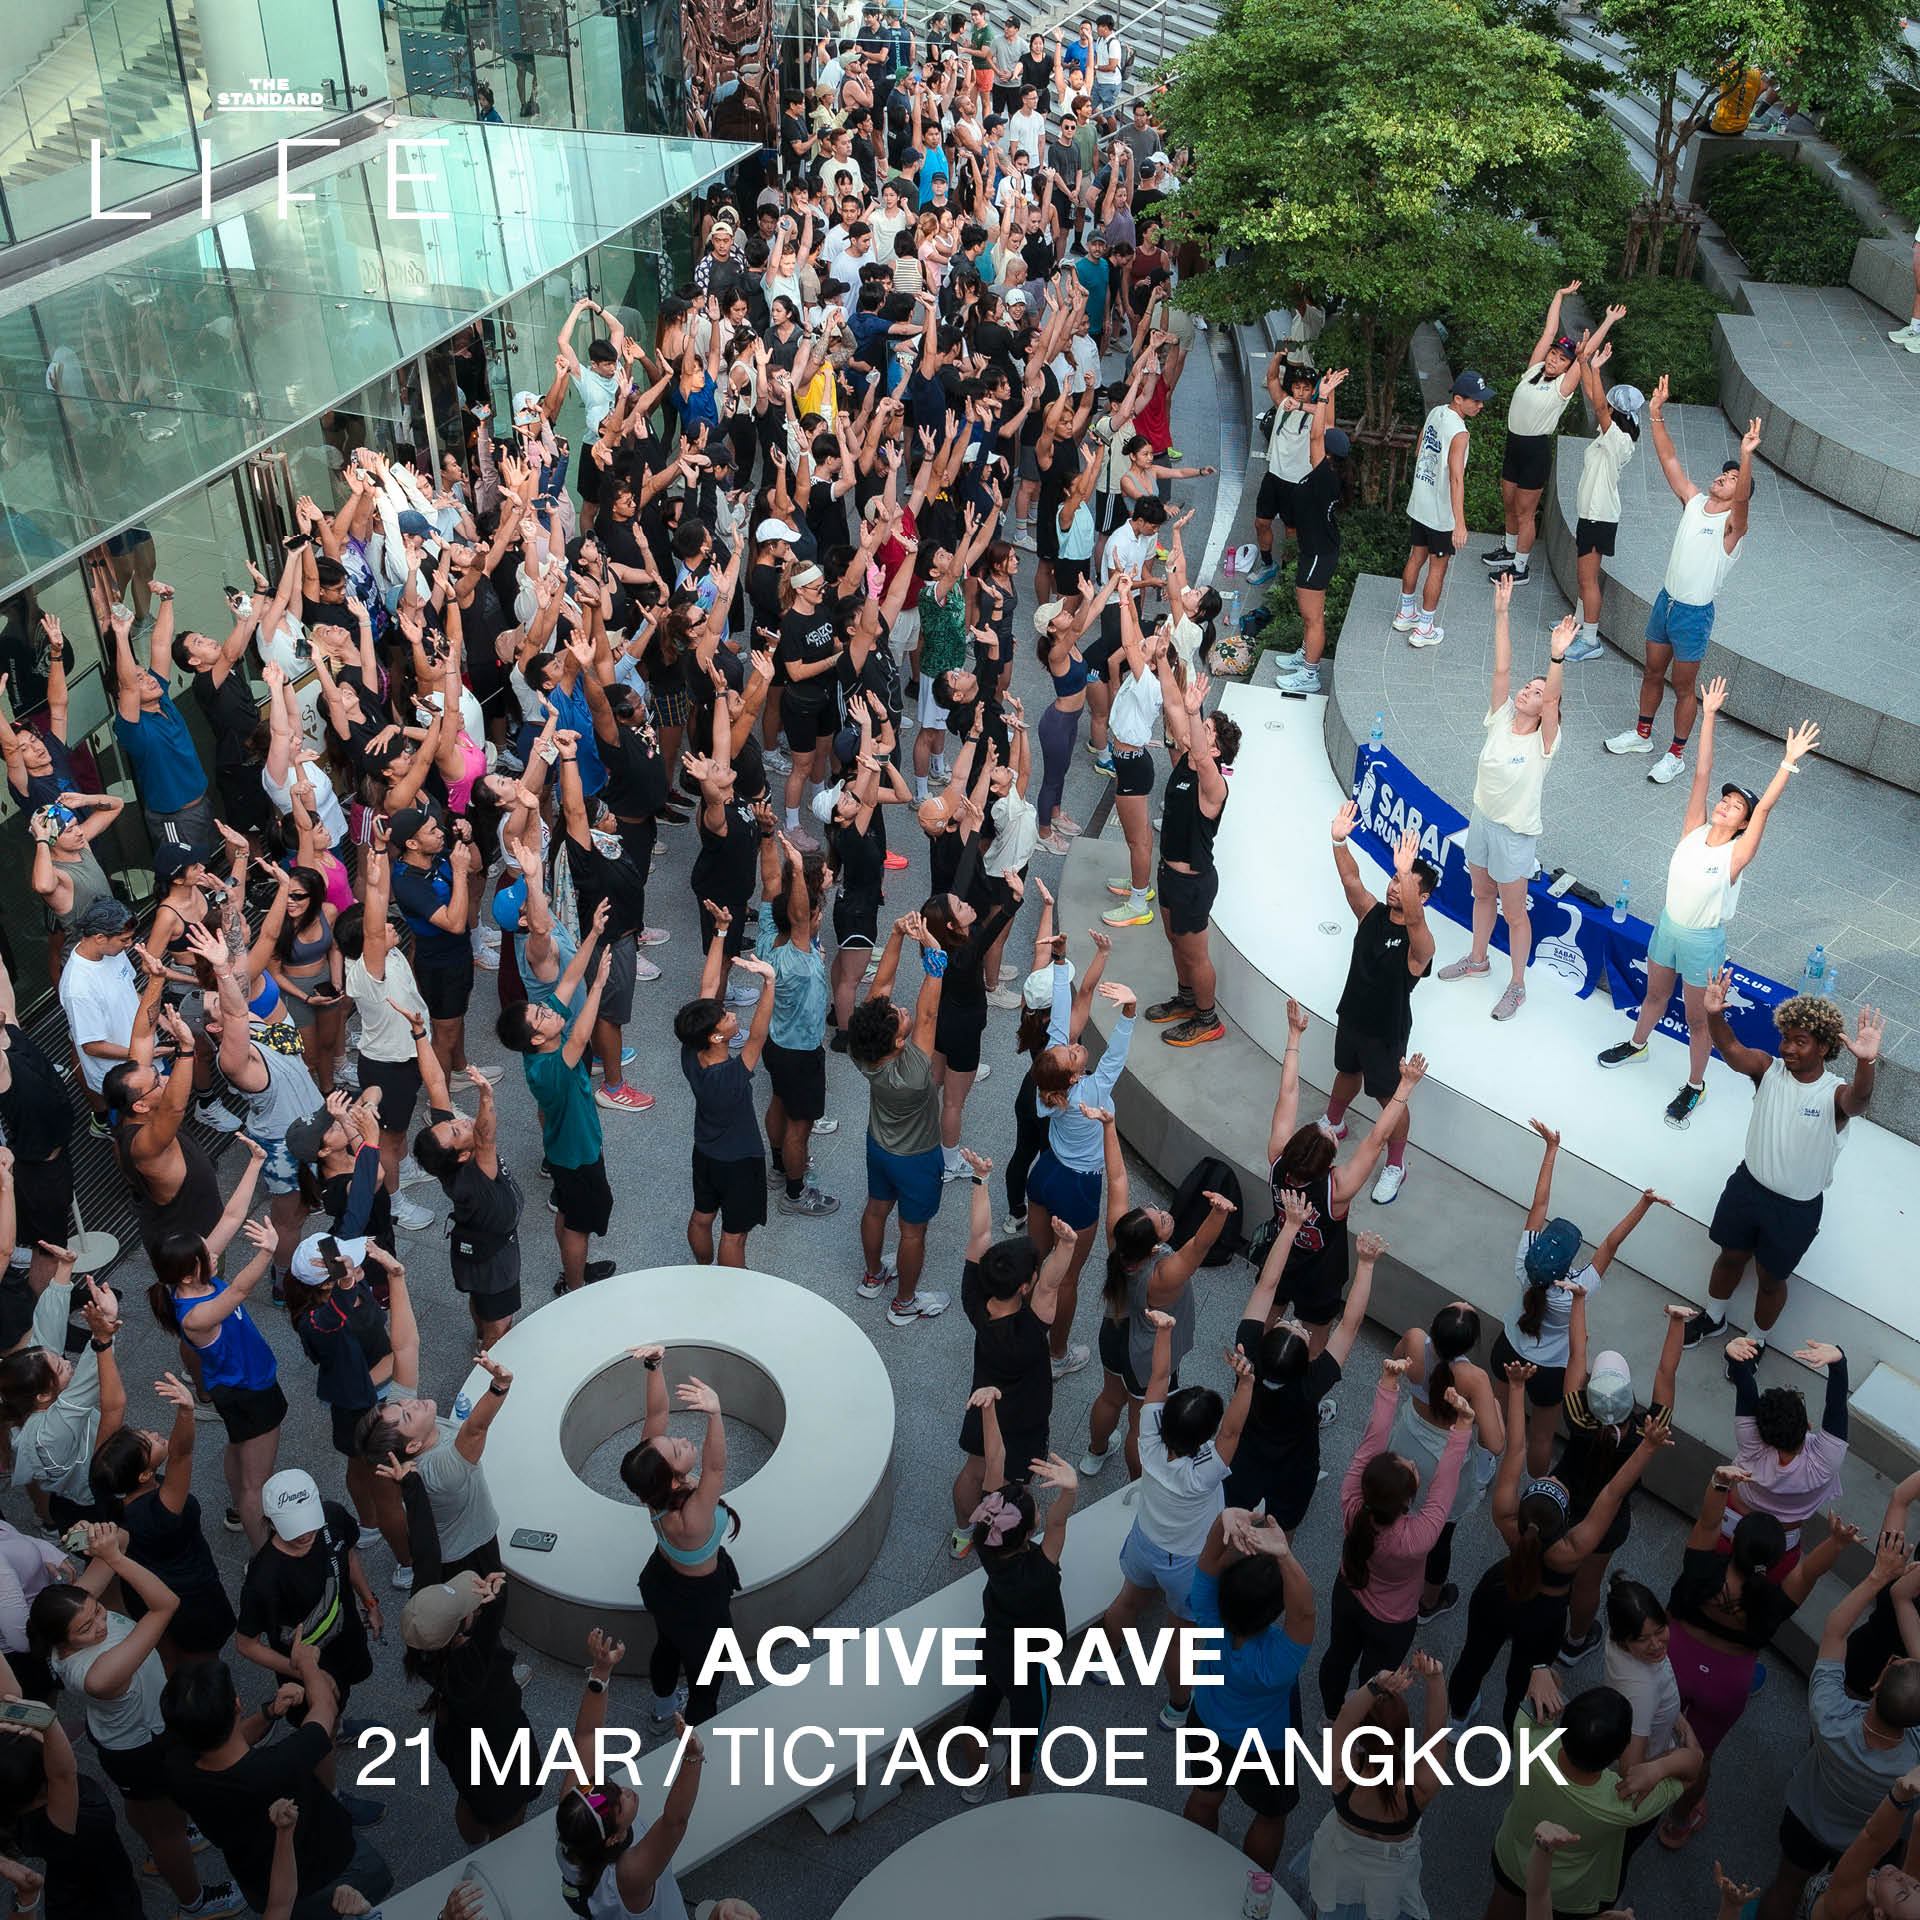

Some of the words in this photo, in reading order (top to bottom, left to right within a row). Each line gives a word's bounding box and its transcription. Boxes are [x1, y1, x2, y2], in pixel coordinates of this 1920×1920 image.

[1378, 783, 1451, 868] SABAI
[1553, 947, 1577, 961] SABAI
[1733, 973, 1773, 994] CLUB
